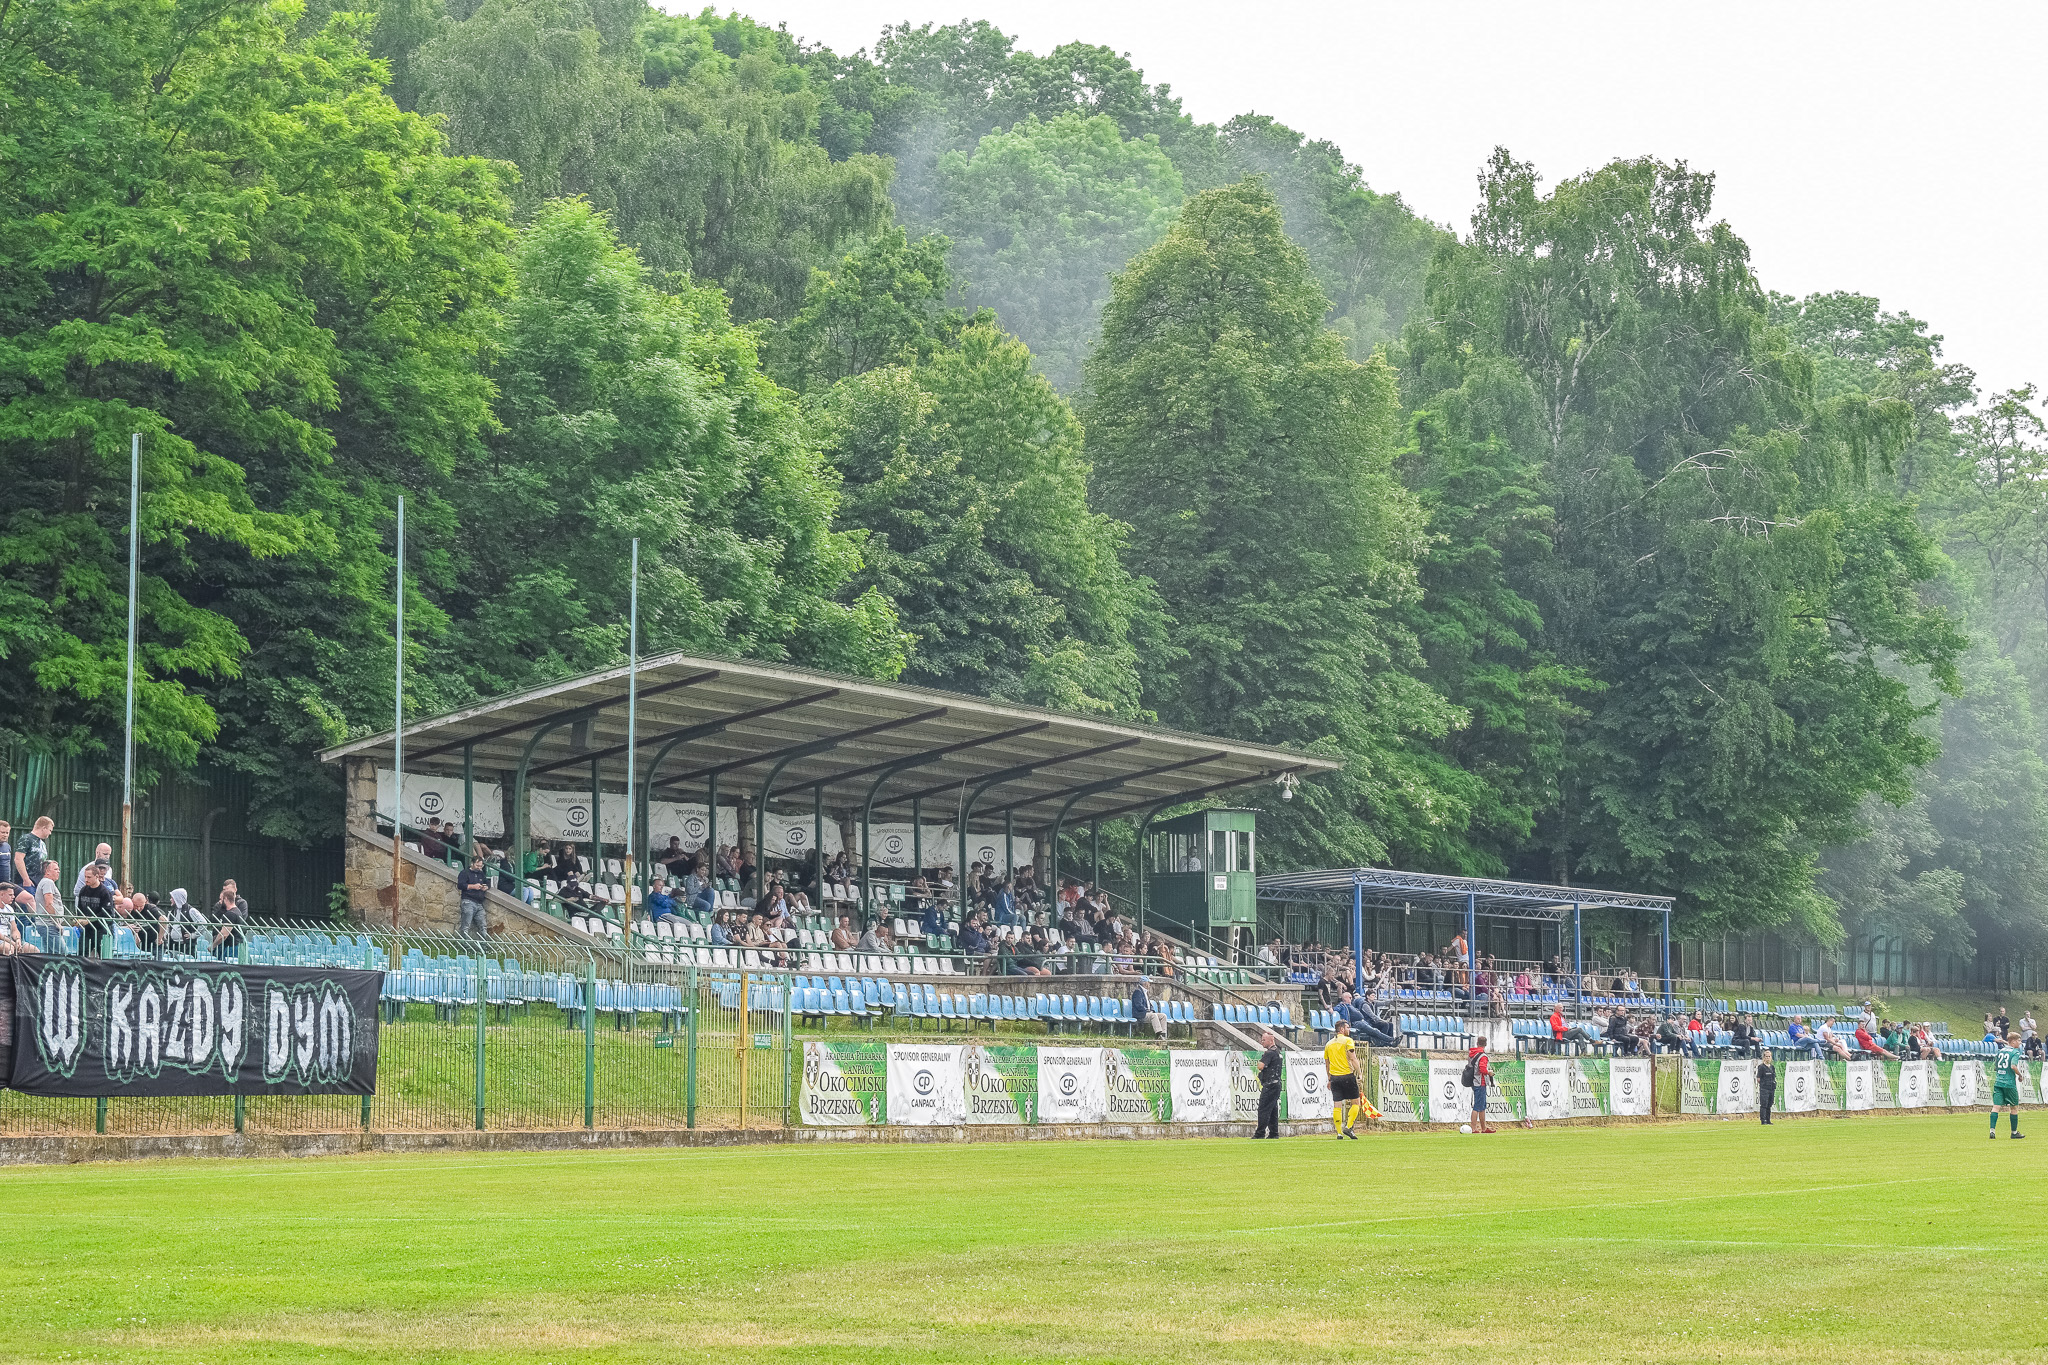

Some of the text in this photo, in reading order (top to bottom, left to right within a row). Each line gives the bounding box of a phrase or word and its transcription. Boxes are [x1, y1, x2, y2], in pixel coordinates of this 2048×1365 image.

[562, 830, 589, 838] CANPACK
[883, 856, 904, 864] CANPACK
[42, 969, 351, 1078] W KAŻDY DYM
[894, 1052, 951, 1062] SPONSOR GENERALNY
[1044, 1056, 1092, 1066] SPONSOR GENERALNY
[1998, 1053, 2009, 1069] 23
[842, 1062, 875, 1075] CANPACK
[1175, 1059, 1194, 1068] SPONSOR
[820, 1072, 885, 1092] OKOCIMSKI
[981, 1074, 1038, 1093] OKOCIMSKI
[1117, 1075, 1169, 1093] OKOCIMSKI
[809, 1095, 863, 1115] BRZESKO
[911, 1099, 936, 1108] CANPACK
[972, 1095, 1018, 1114] BRZESKO
[1058, 1099, 1079, 1107] CANPACK
[1110, 1095, 1152, 1113] BRZESKO
[1187, 1099, 1206, 1107] CANPACK
[1302, 1097, 1319, 1105] CANPACK
[1383, 1097, 1414, 1114] BRZESKO
[1486, 1103, 1512, 1114] RZESKO
